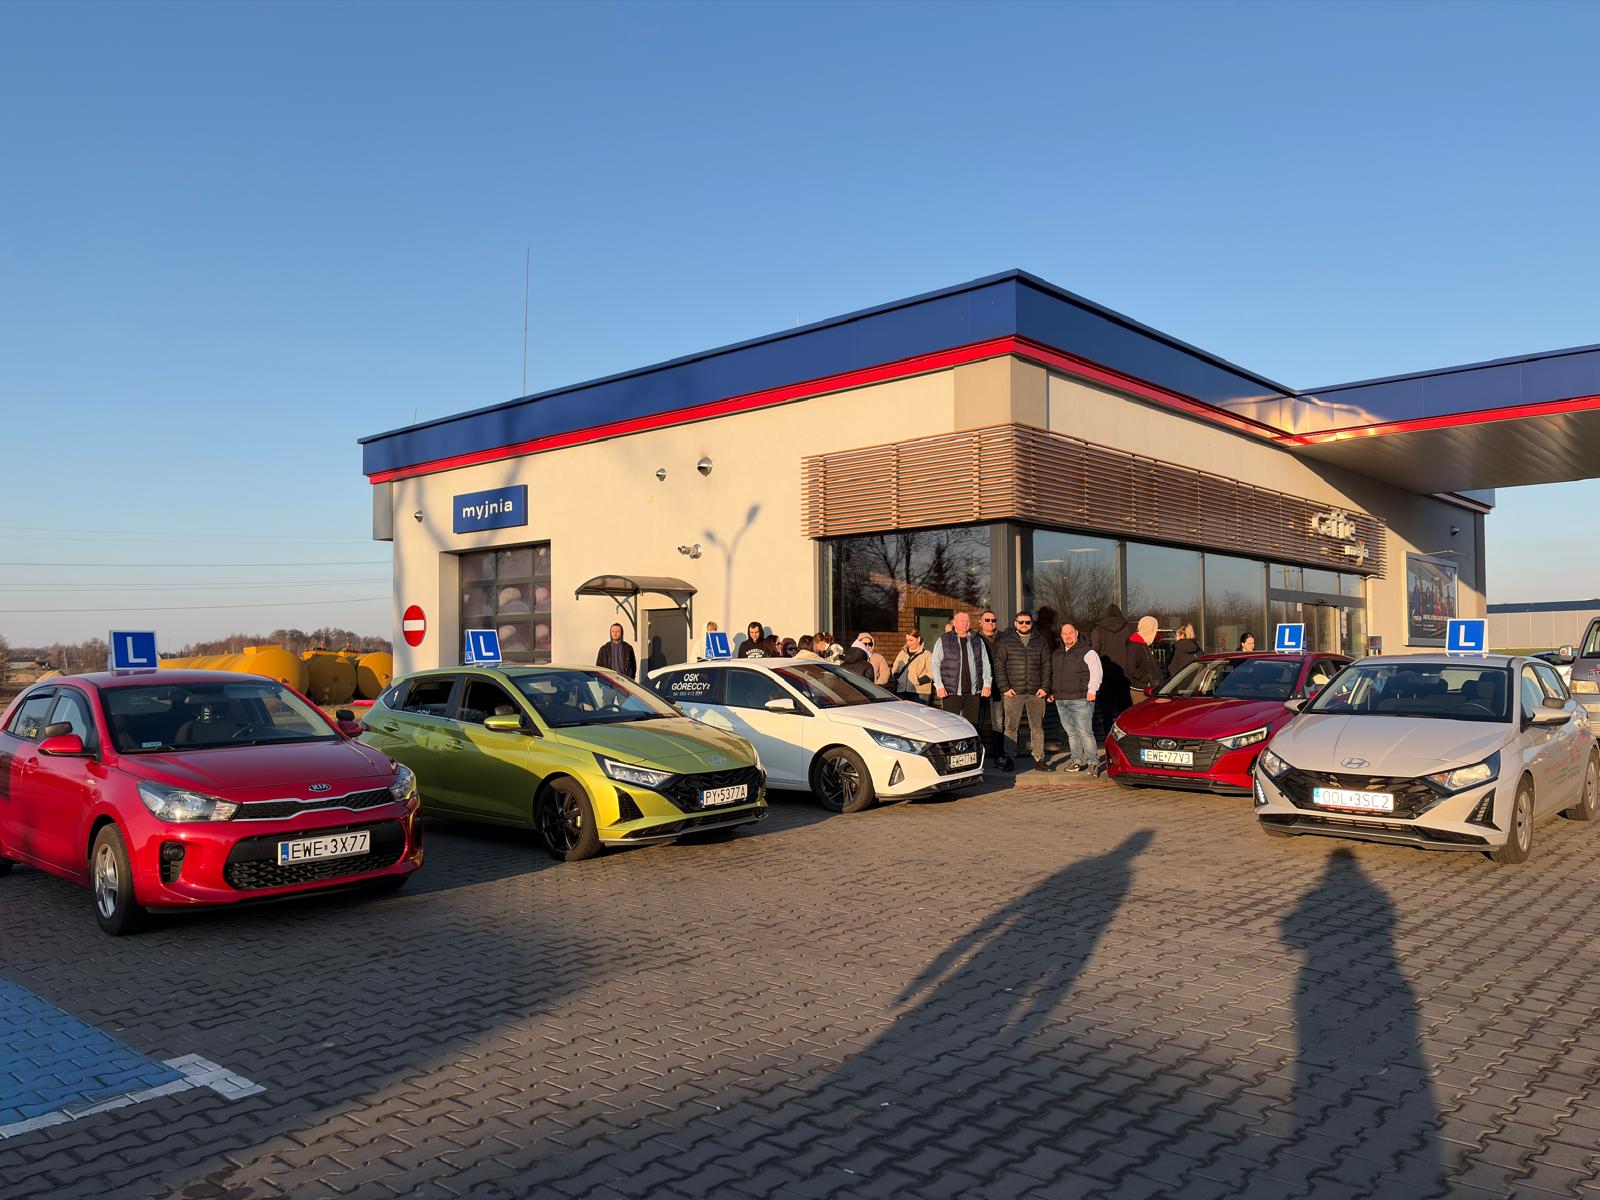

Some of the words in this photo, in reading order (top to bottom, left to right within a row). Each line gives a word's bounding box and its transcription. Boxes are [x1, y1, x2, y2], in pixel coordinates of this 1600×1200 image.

[462, 498, 513, 520] myjnia
[715, 635, 727, 654] L
[1284, 628, 1296, 646] L
[1459, 624, 1476, 647] L
[126, 636, 148, 663] L
[479, 635, 495, 656] L
[683, 673, 700, 682] OSK
[1146, 750, 1164, 762] EWE
[1167, 752, 1191, 764] 77V3
[705, 790, 718, 804] PY
[720, 786, 746, 801] 5377A
[1353, 793, 1389, 809] 3SC2
[291, 840, 323, 859] EWE
[330, 834, 367, 854] 3X77
